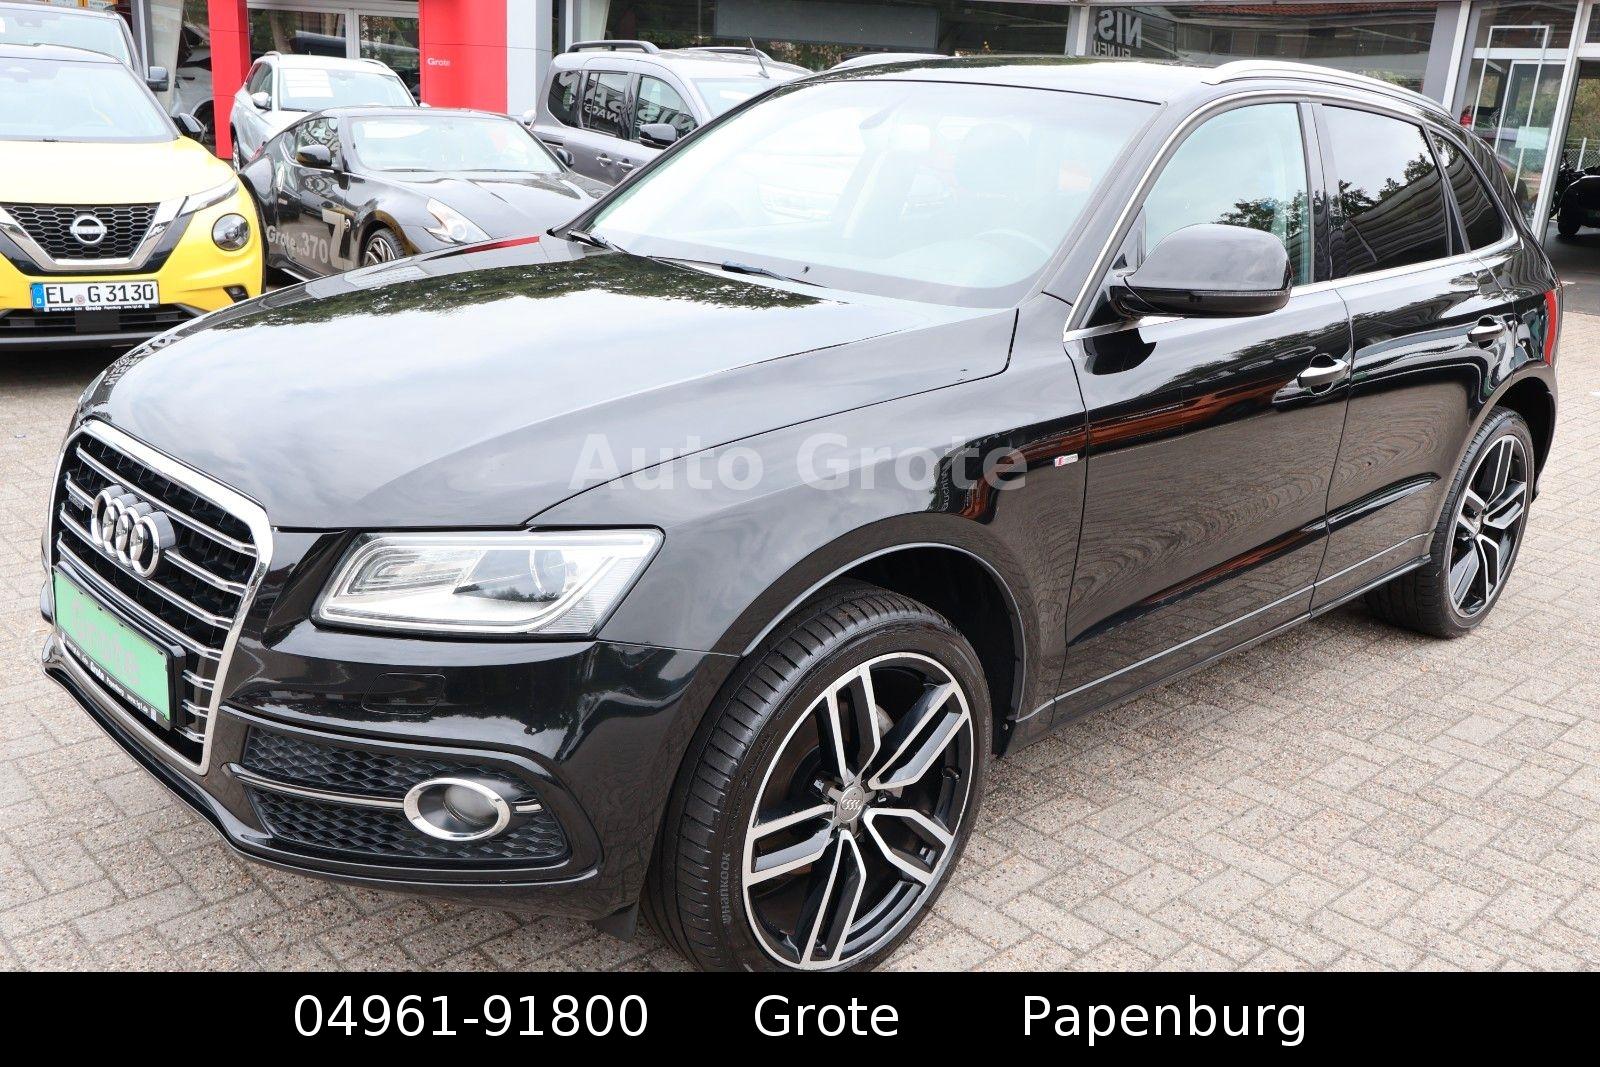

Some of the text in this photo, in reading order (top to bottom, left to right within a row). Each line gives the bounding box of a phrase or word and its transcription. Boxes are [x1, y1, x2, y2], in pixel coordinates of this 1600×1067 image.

[45, 286, 74, 304] EL
[87, 285, 101, 303] G
[105, 283, 154, 302] 3130
